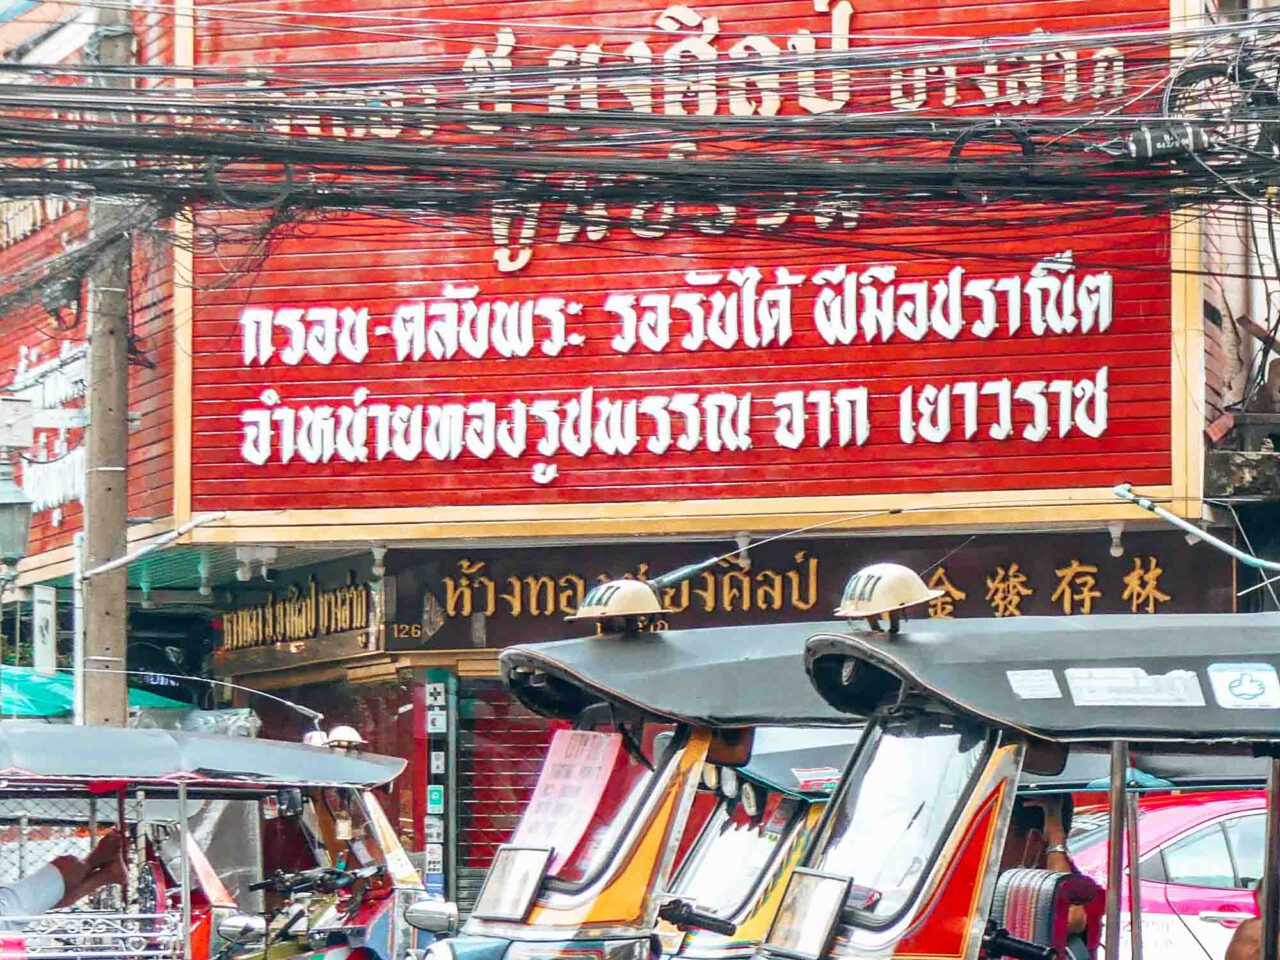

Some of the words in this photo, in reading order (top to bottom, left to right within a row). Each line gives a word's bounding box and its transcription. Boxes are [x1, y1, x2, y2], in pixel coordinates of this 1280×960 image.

[773, 386, 870, 450] จาก
[901, 366, 1108, 444] เยาวราช
[393, 624, 421, 638] 126
